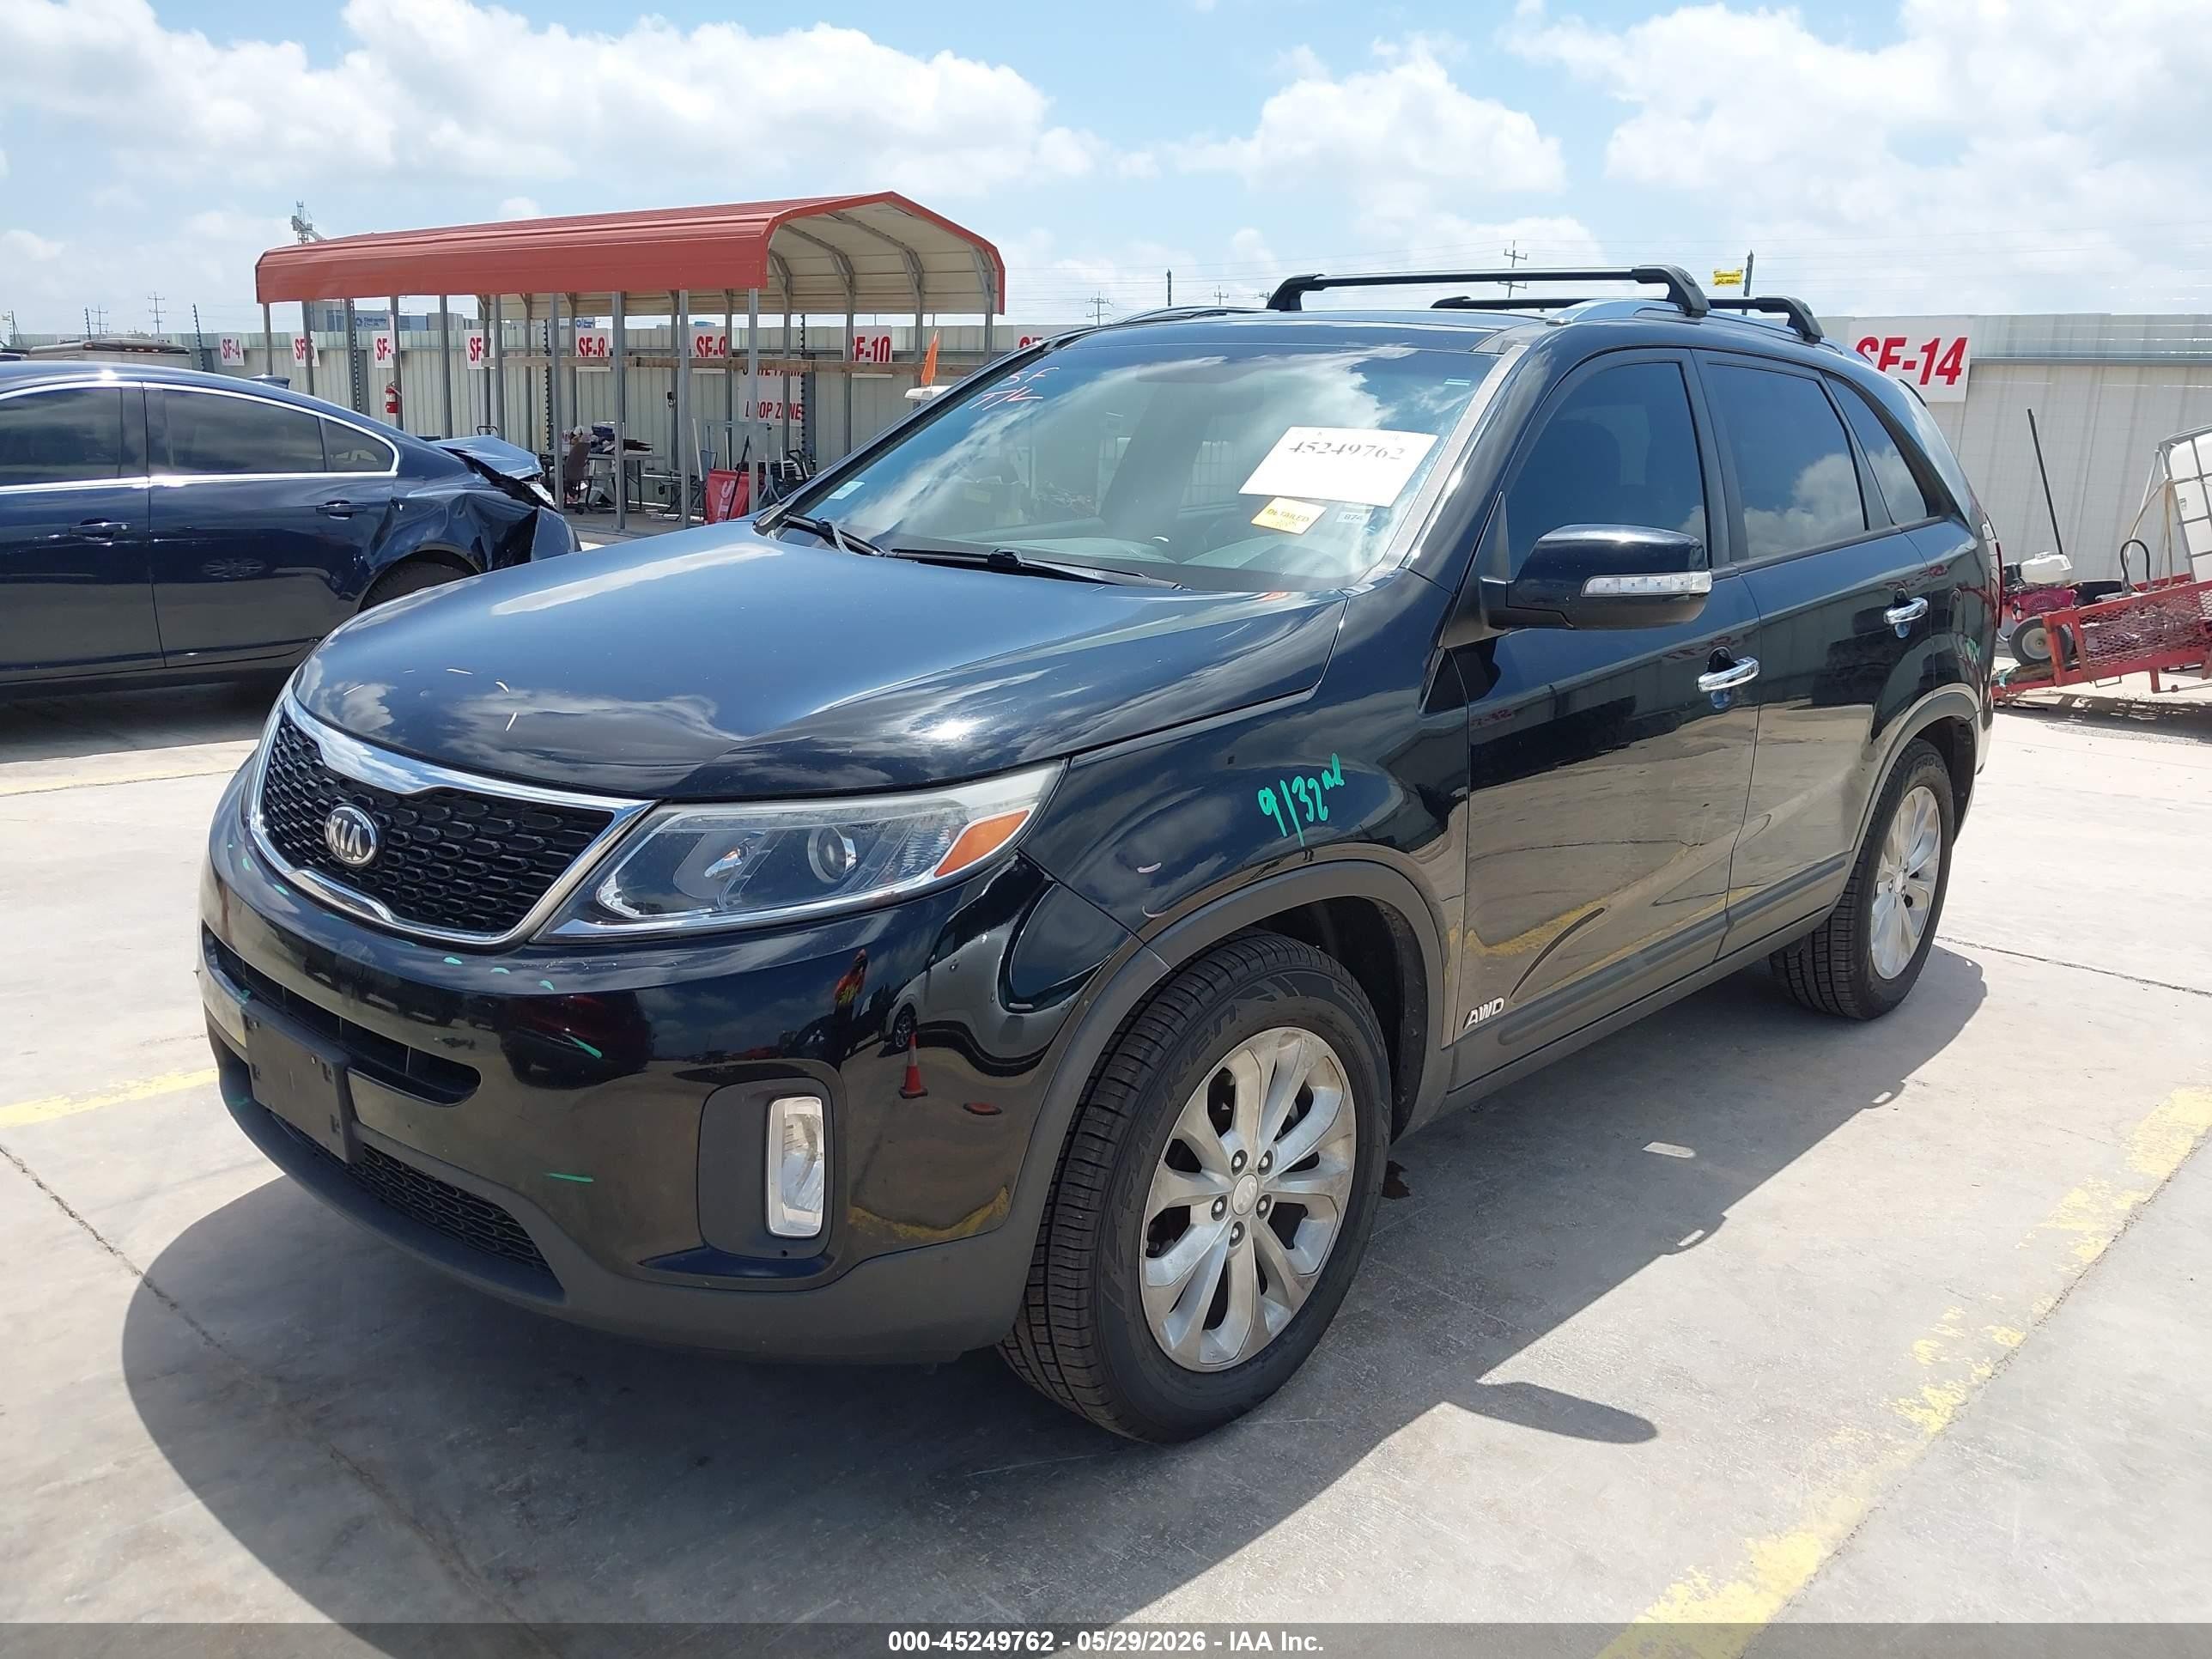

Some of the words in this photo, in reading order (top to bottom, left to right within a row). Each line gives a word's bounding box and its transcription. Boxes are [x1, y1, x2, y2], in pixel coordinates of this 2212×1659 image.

[222, 338, 240, 360] SF-4
[1288, 441, 1406, 460] 45249762
[1462, 996, 1504, 1030] AWD
